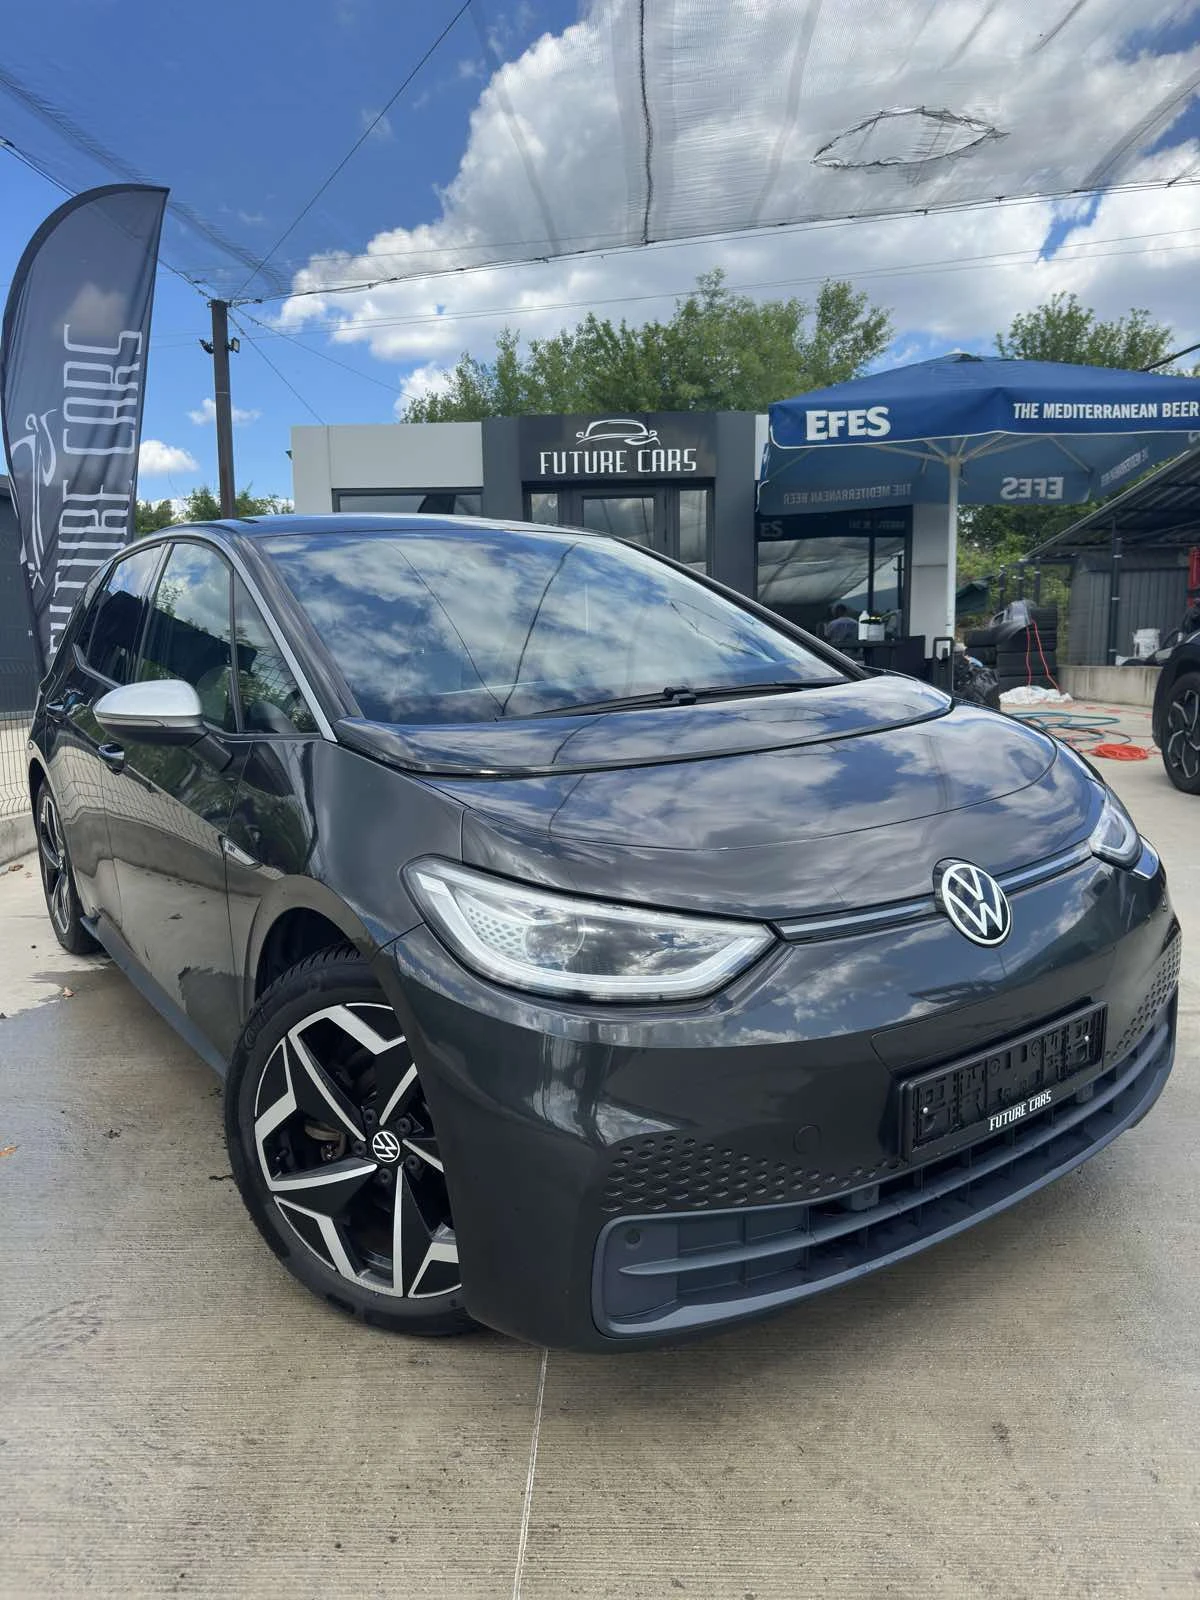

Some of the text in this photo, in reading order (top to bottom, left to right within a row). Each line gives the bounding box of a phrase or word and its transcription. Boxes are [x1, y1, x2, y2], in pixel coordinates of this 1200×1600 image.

[806, 406, 892, 441] EFES
[1013, 401, 1200, 419] THE MEDITERRANEAN BEER
[539, 448, 697, 475] FUTURE CARS
[49, 323, 143, 654] TURE CARS
[988, 1089, 1052, 1131] FUTURE CARS
